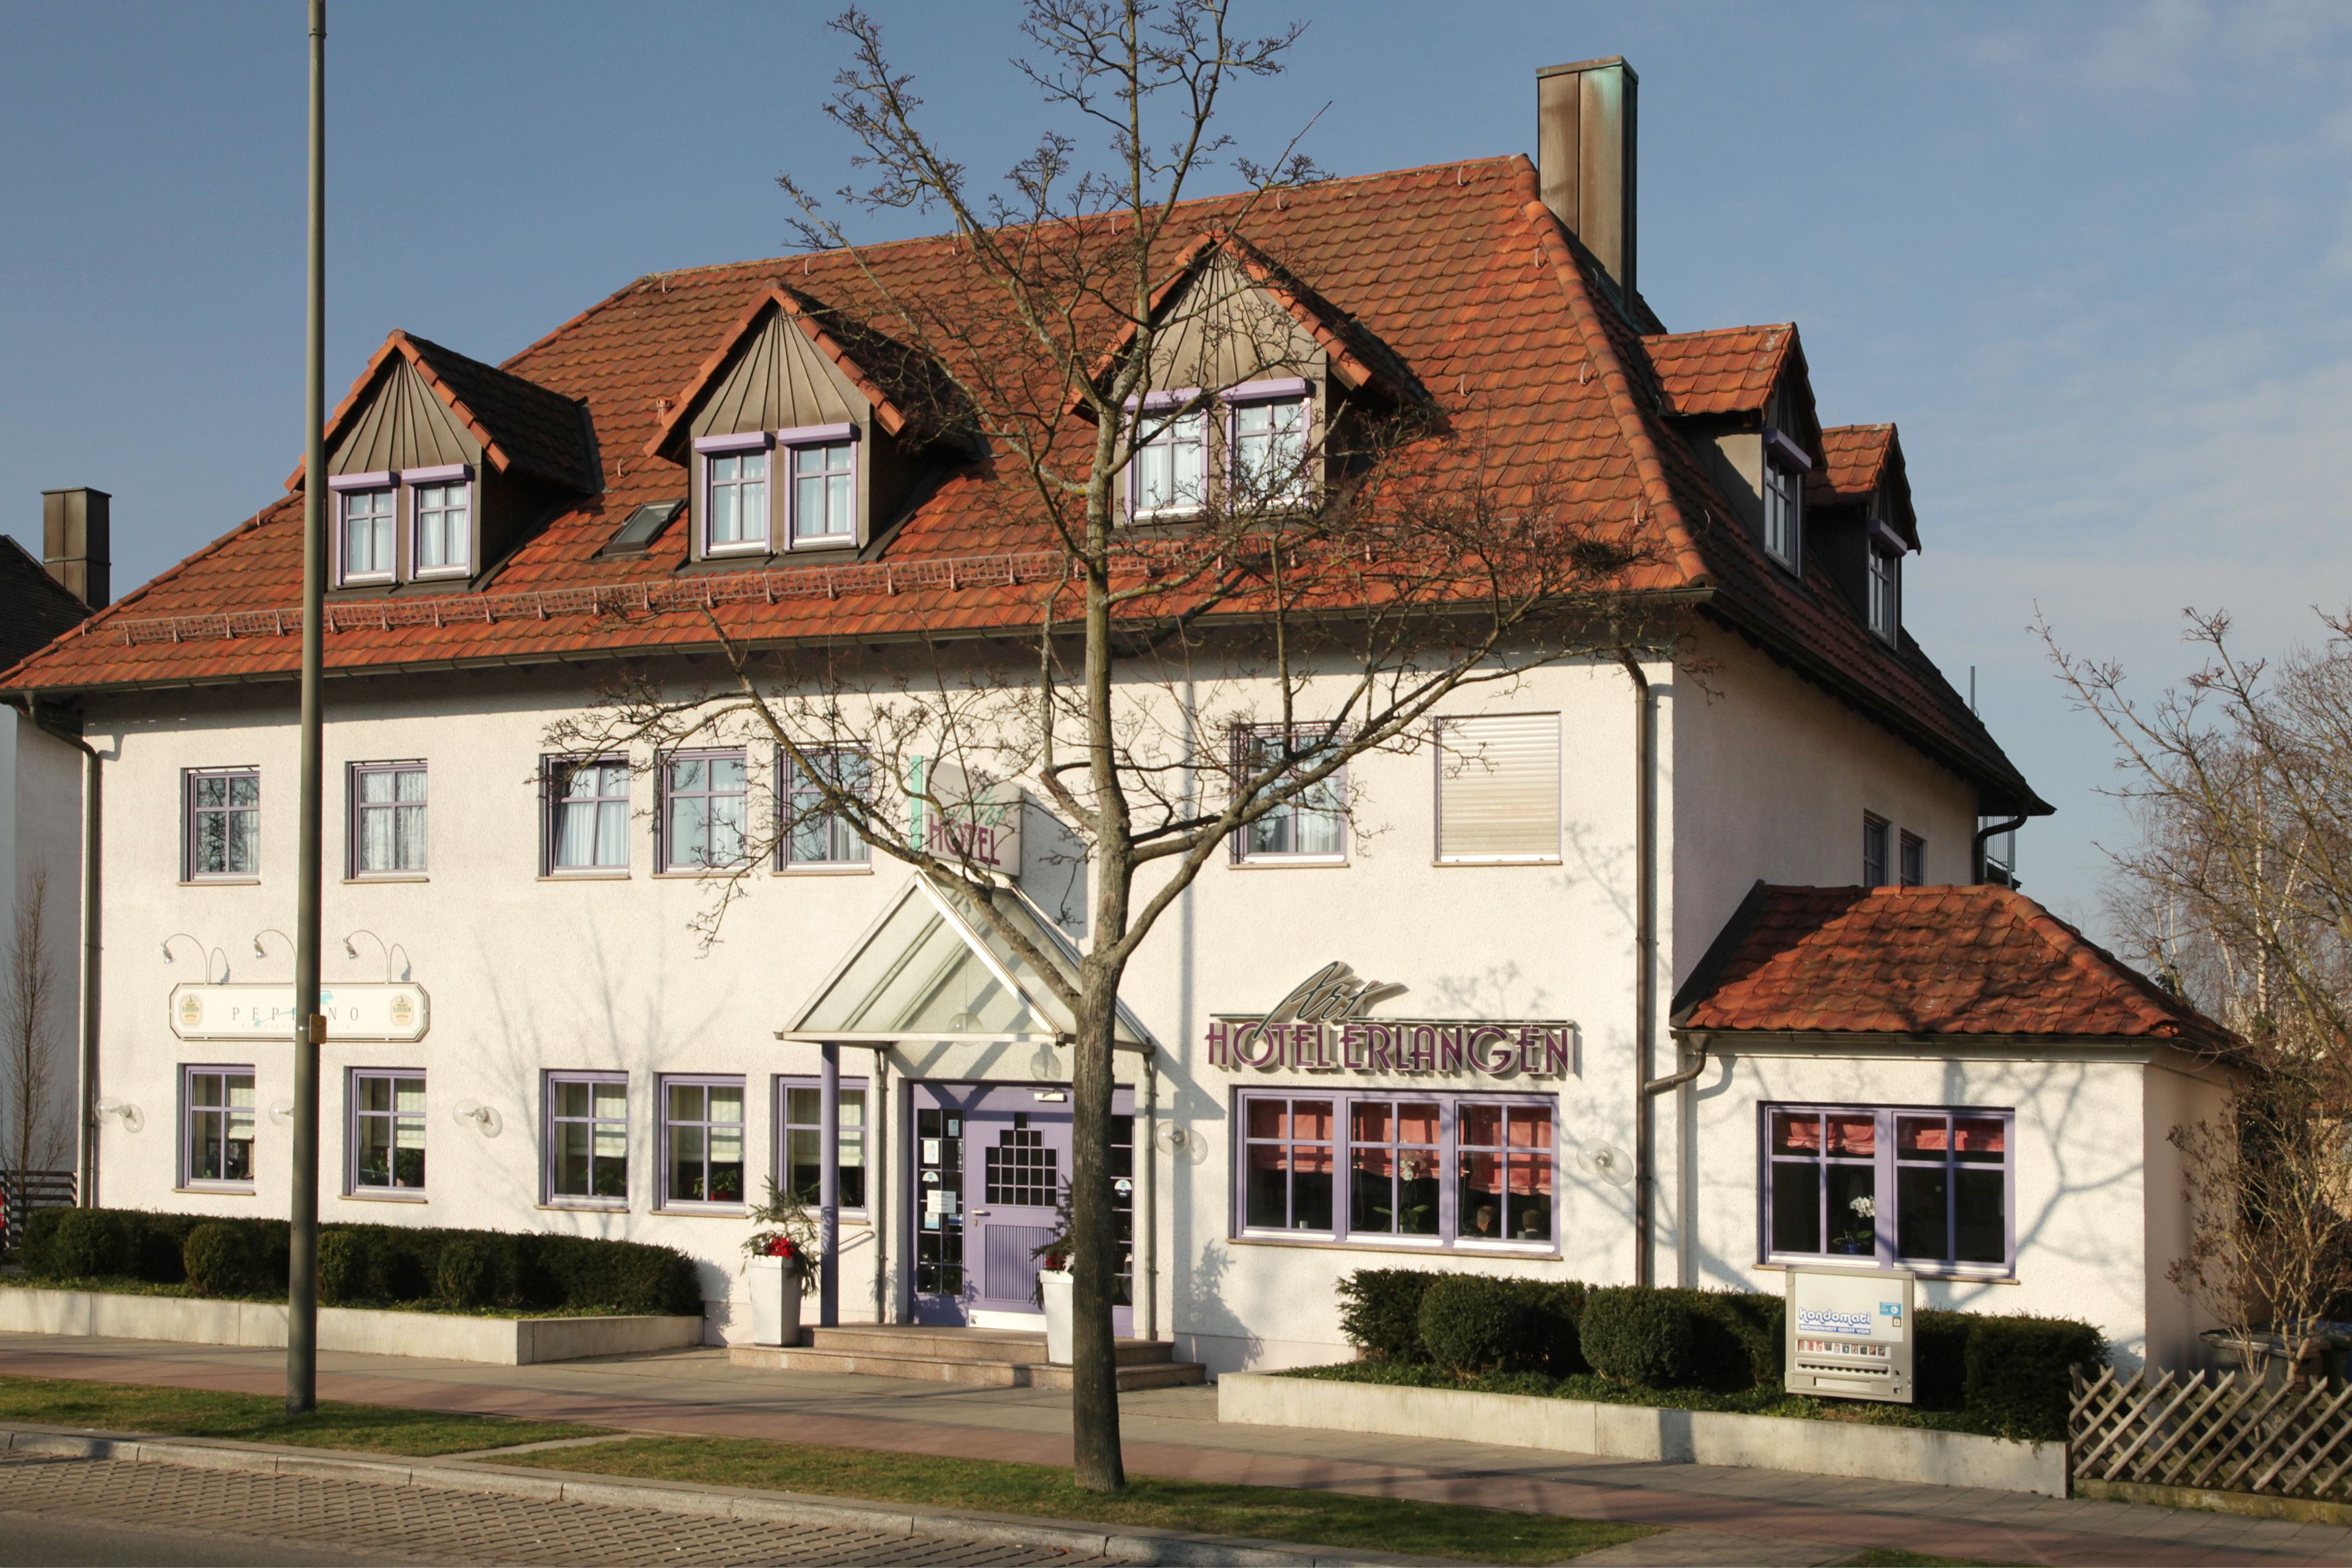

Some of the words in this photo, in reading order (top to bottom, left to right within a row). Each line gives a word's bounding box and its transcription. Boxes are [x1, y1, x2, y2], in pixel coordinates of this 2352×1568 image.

[928, 813, 1000, 866] HOTEL
[232, 1007, 359, 1021] PEPPNO
[1253, 961, 1400, 1040] Art
[1204, 1022, 1332, 1067] HOTEL
[1339, 1024, 1569, 1075] ERLANGEN
